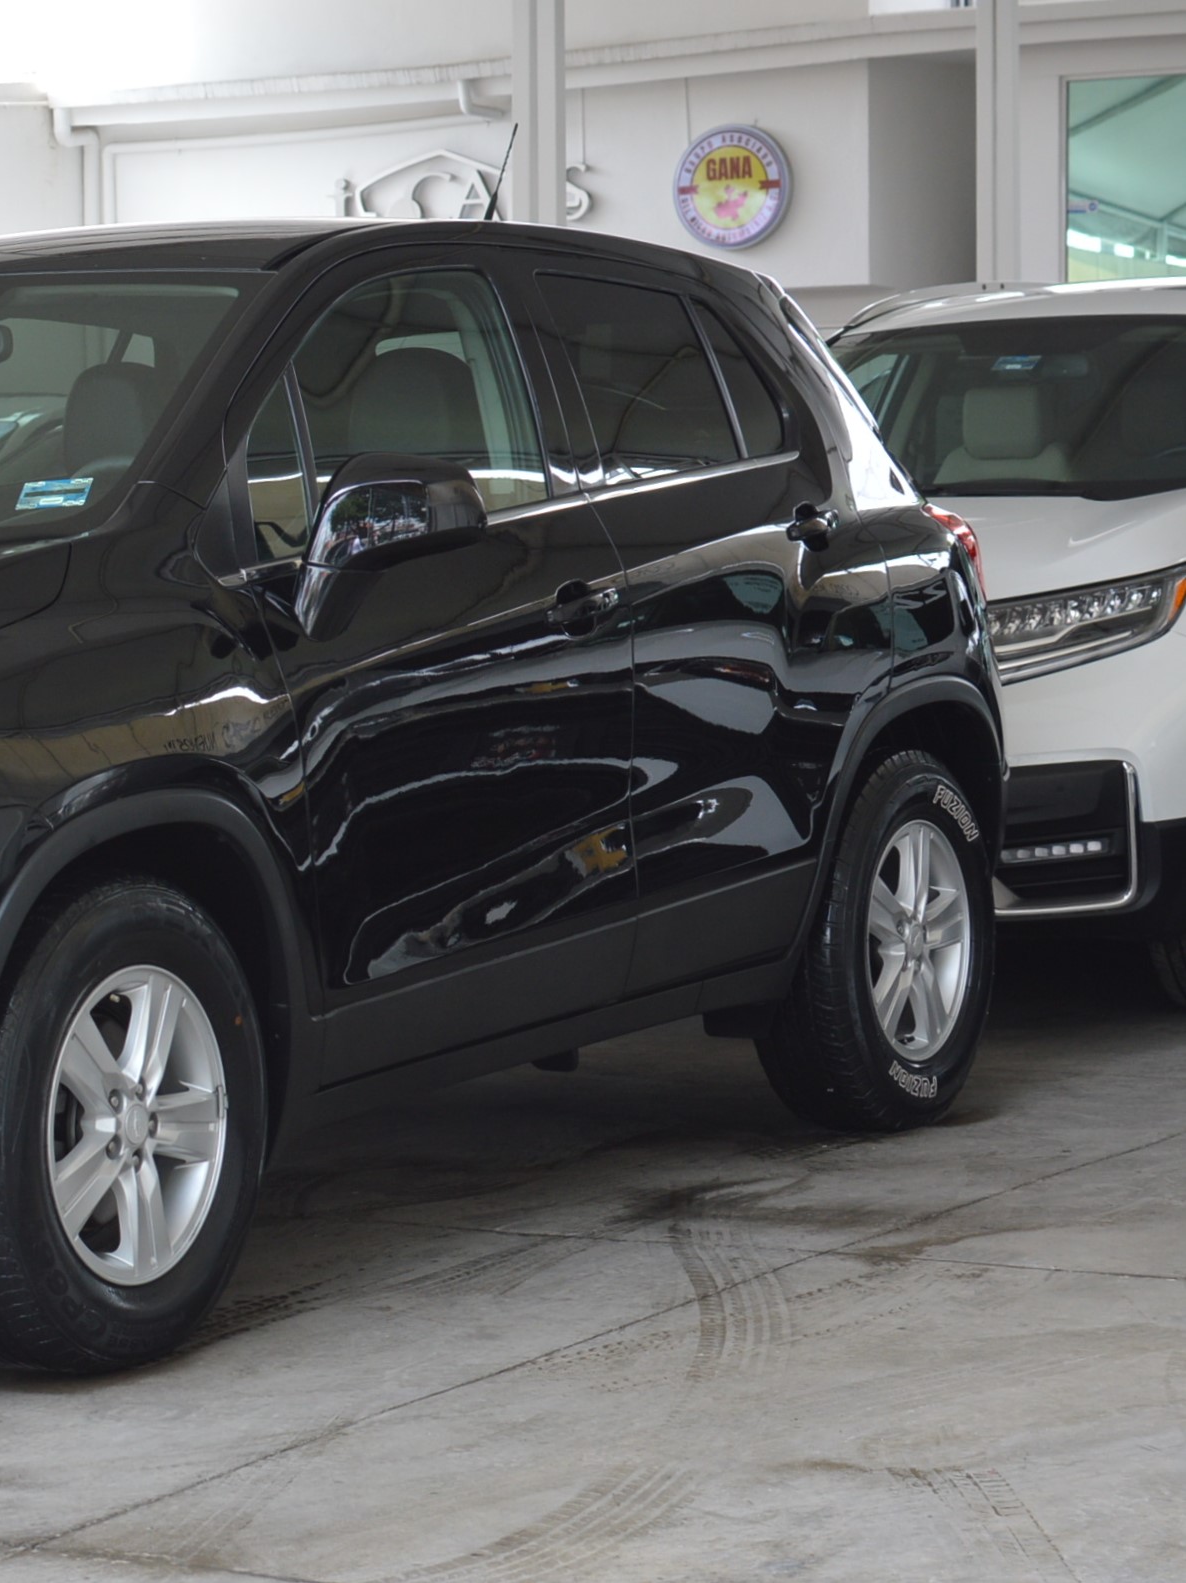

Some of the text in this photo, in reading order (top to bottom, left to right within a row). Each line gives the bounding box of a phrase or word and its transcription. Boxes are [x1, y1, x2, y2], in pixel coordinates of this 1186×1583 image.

[706, 155, 753, 182] GANA
[932, 784, 980, 842] FUZION
[888, 1060, 938, 1099] FUZION
